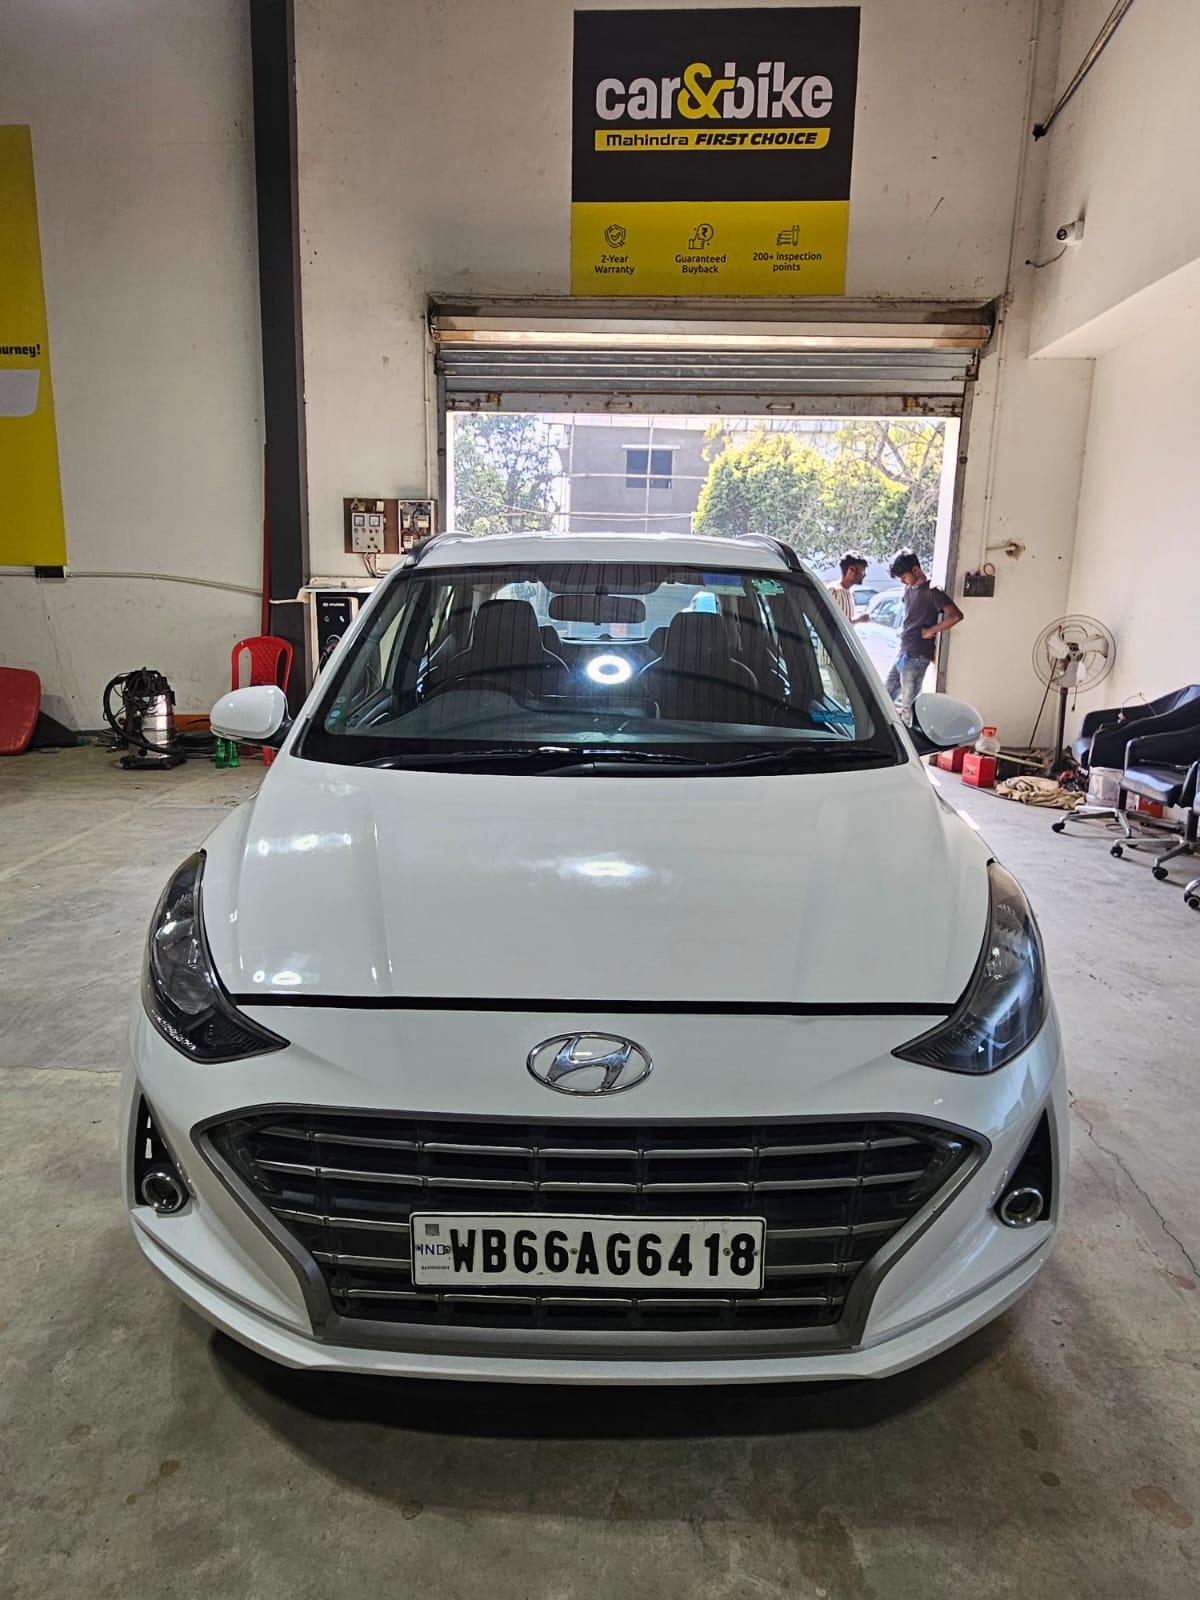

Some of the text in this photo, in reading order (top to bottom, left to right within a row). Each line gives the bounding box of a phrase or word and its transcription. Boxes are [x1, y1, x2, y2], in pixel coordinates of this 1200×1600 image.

[595, 61, 833, 121] car&bike
[606, 132, 818, 147] Mahindra FIRST CHOICE
[601, 254, 629, 264] 2-Year
[675, 254, 727, 264] Guaranteed
[752, 252, 822, 264] 200+ inspection
[594, 266, 635, 276] Warranty
[682, 265, 719, 275] Buyback
[773, 262, 801, 273] points
[0, 343, 41, 358] urney!
[420, 1243, 446, 1256] IND
[449, 1228, 757, 1277] WB66AG6418
